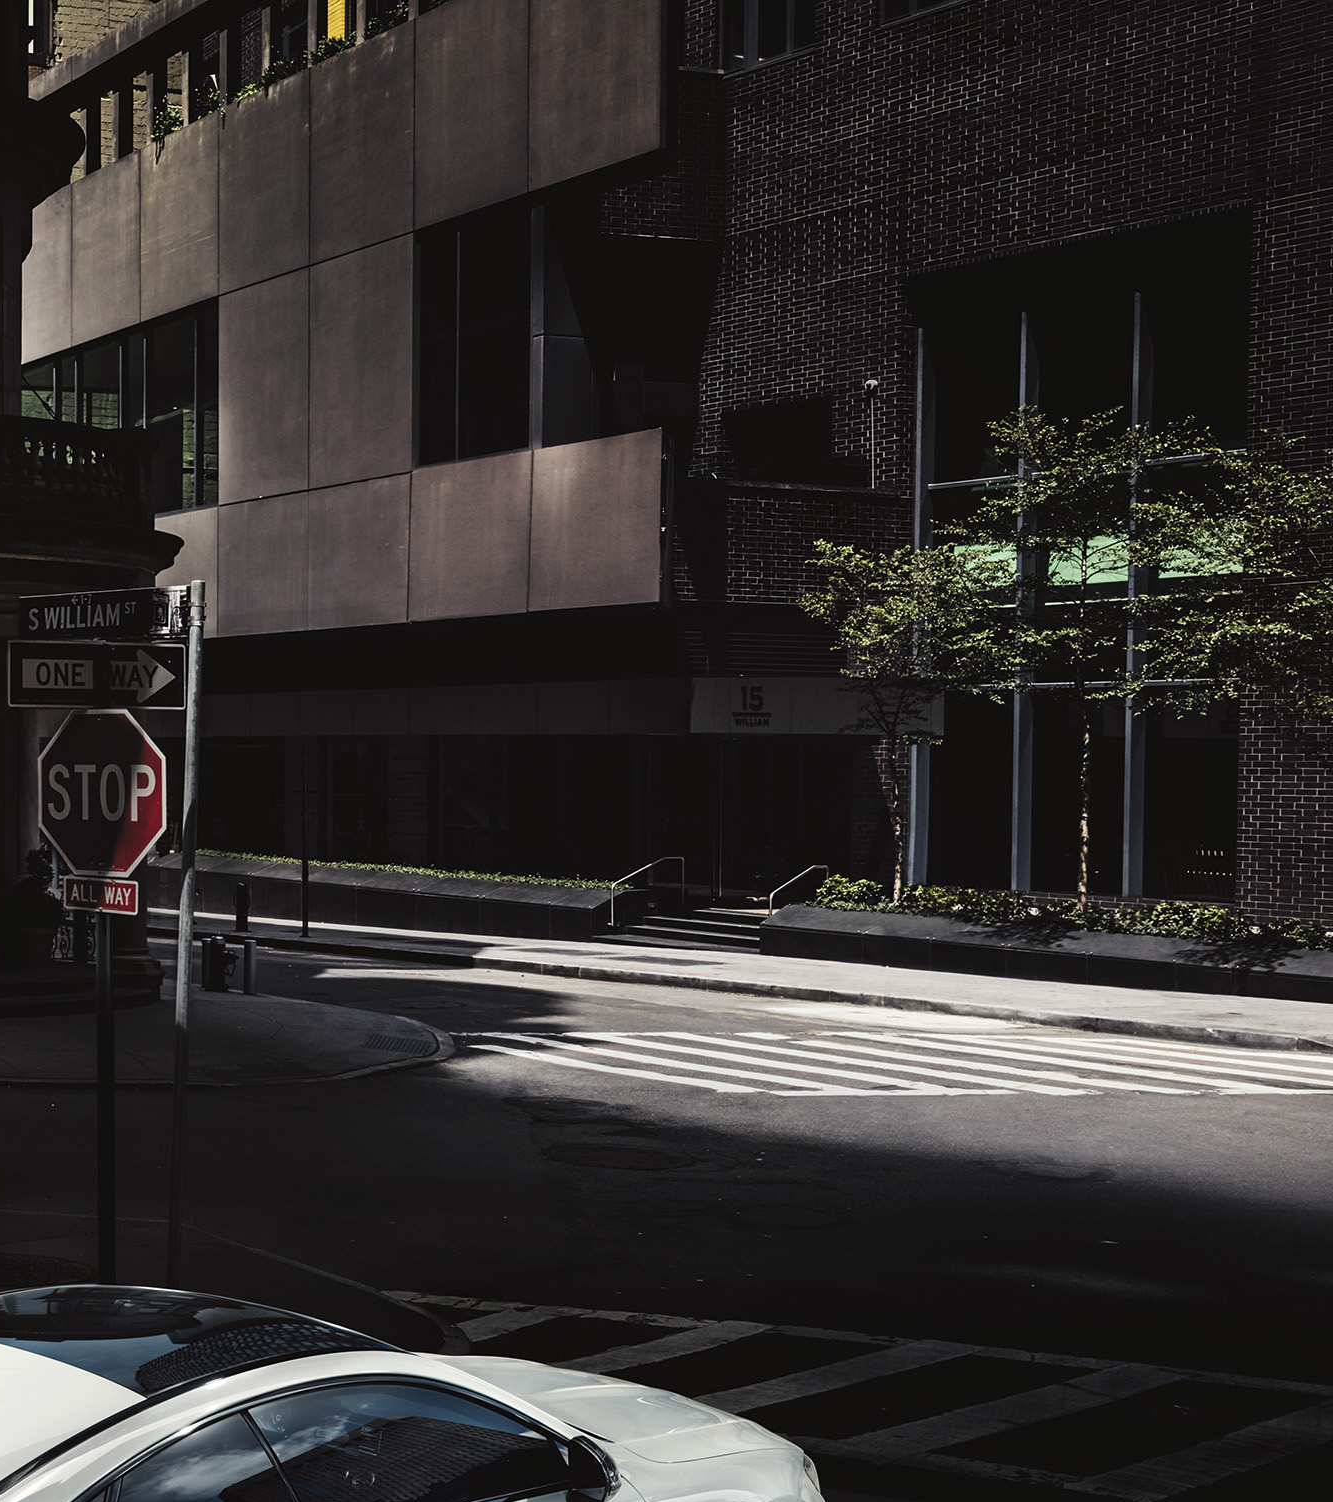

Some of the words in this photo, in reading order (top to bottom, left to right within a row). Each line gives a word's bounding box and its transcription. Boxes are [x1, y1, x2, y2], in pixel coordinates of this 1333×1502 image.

[28, 607, 39, 631] S
[44, 602, 120, 629] WILLIAM
[125, 601, 137, 614] ST
[36, 662, 85, 687] ONE
[110, 664, 159, 688] WAY
[741, 685, 764, 712] 15
[734, 717, 770, 728] WILLIAM
[47, 763, 157, 822] STOP
[70, 884, 97, 903] ALL
[104, 886, 132, 906] WAY
